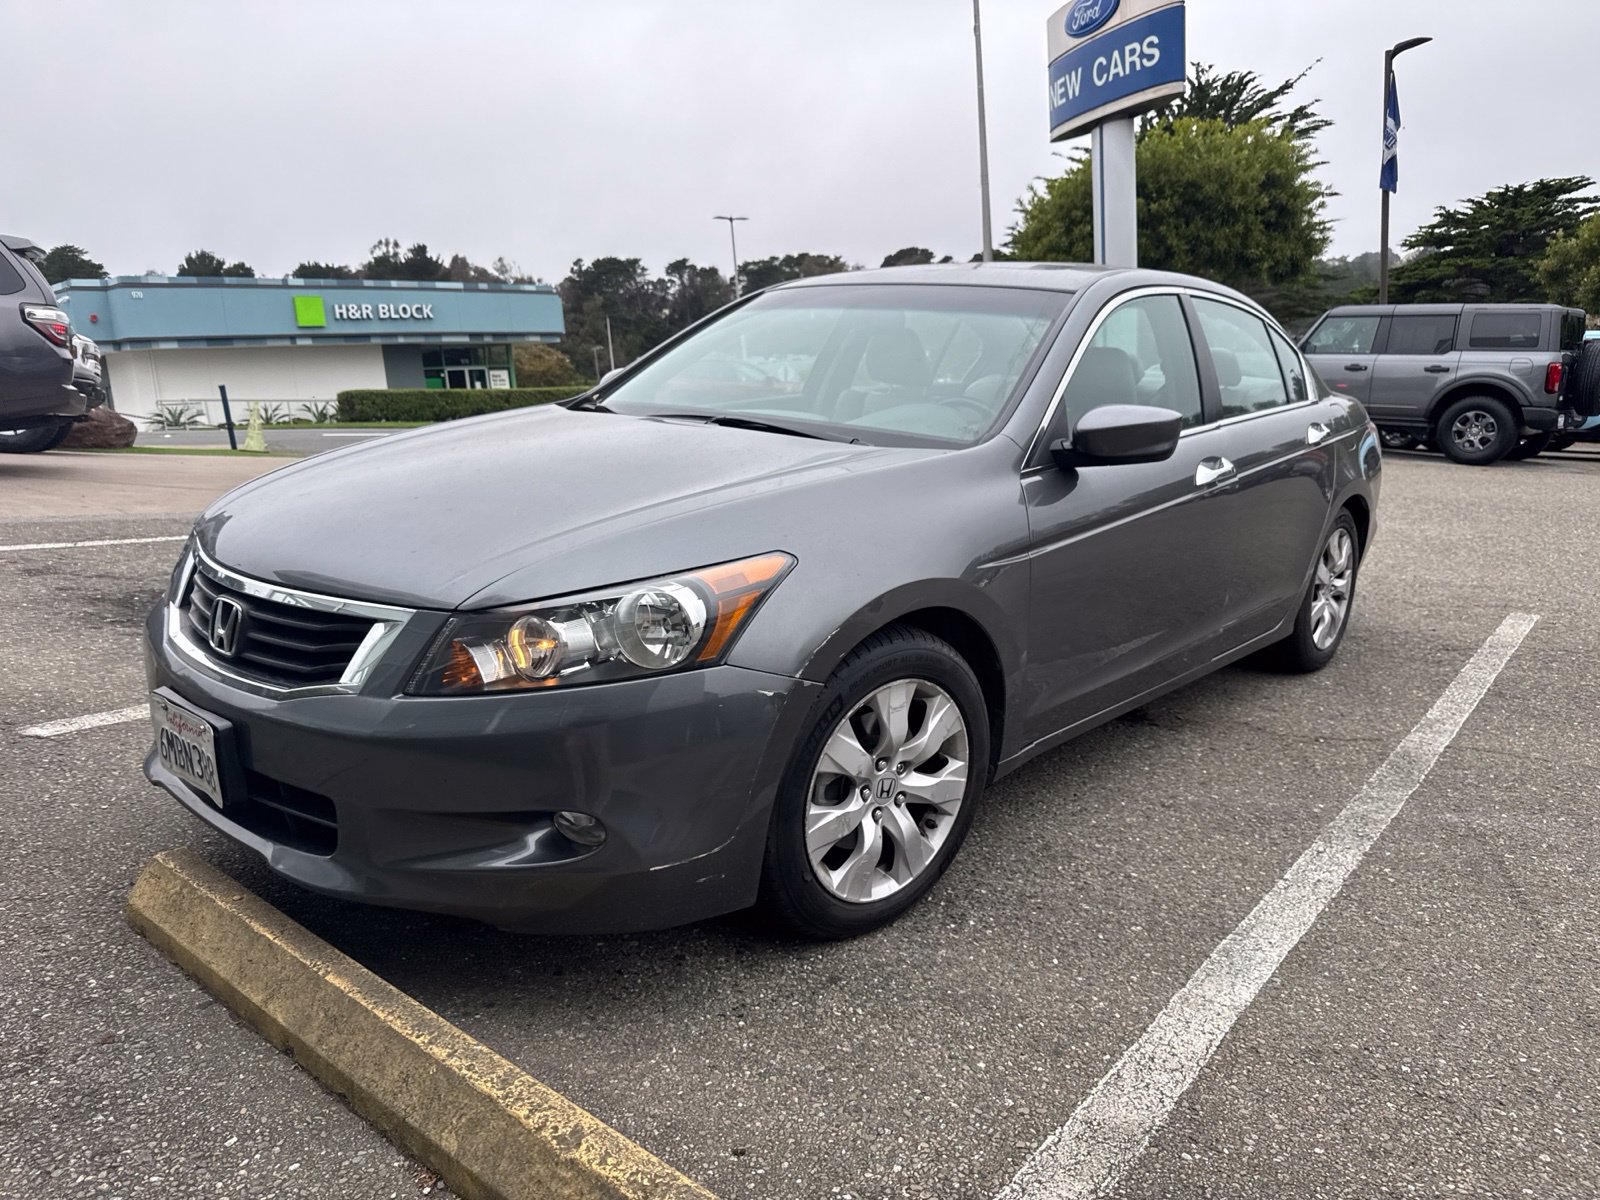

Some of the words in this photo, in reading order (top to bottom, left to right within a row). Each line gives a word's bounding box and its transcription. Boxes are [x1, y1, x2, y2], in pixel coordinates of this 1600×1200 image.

[1072, 0, 1101, 30] Ford
[1050, 67, 1082, 111] NEW
[1092, 35, 1160, 86] CARS
[334, 304, 373, 319] H&R
[378, 304, 433, 319] BLOCK
